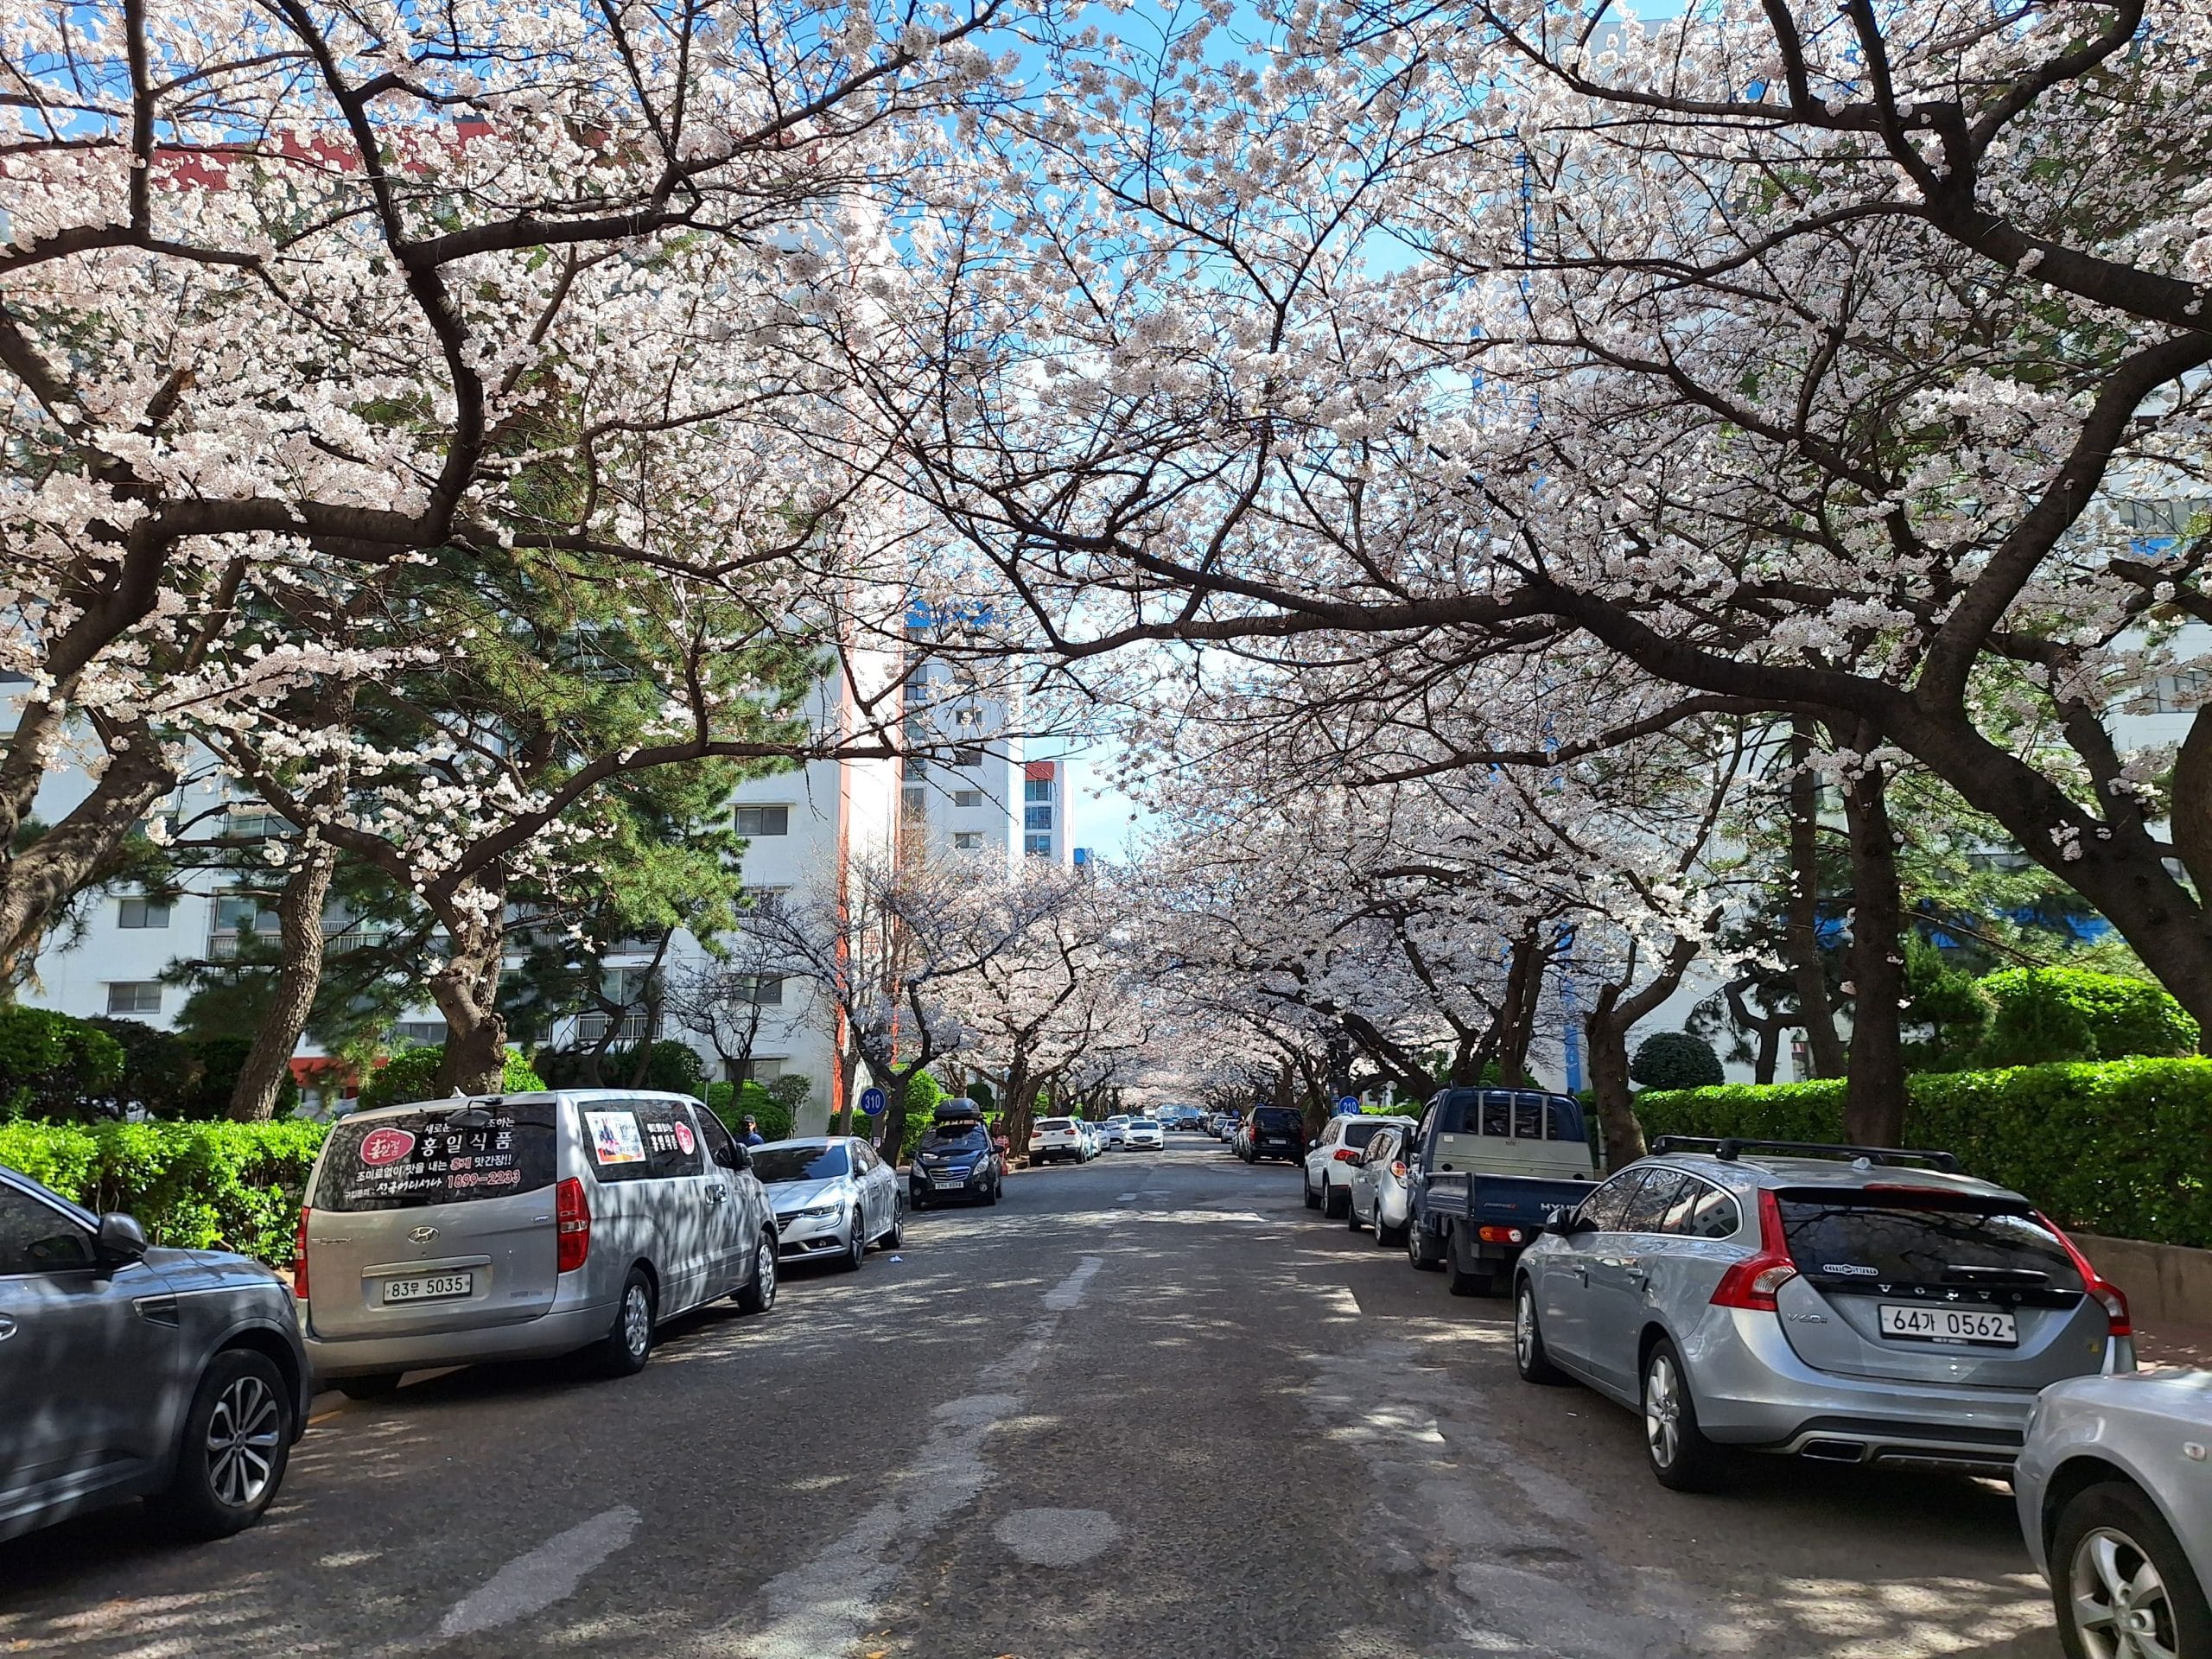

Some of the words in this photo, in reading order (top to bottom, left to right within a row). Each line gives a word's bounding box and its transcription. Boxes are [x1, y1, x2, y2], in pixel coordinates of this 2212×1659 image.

[865, 1094, 880, 1109] 310
[1343, 1102, 1357, 1113] 210
[424, 1123, 451, 1135] 새로운
[482, 1117, 516, 1129] 조하는
[421, 1131, 513, 1157] 홍일식품
[405, 1161, 425, 1175] 맛을
[429, 1160, 448, 1173] 내는
[474, 1154, 512, 1167] 맛간장!!
[447, 1169, 521, 1189] 1899-2233
[391, 1282, 420, 1298] 83무
[426, 1276, 463, 1294] 5035
[1893, 1310, 1936, 1332] 64가
[1948, 1313, 2005, 1338] 0562
